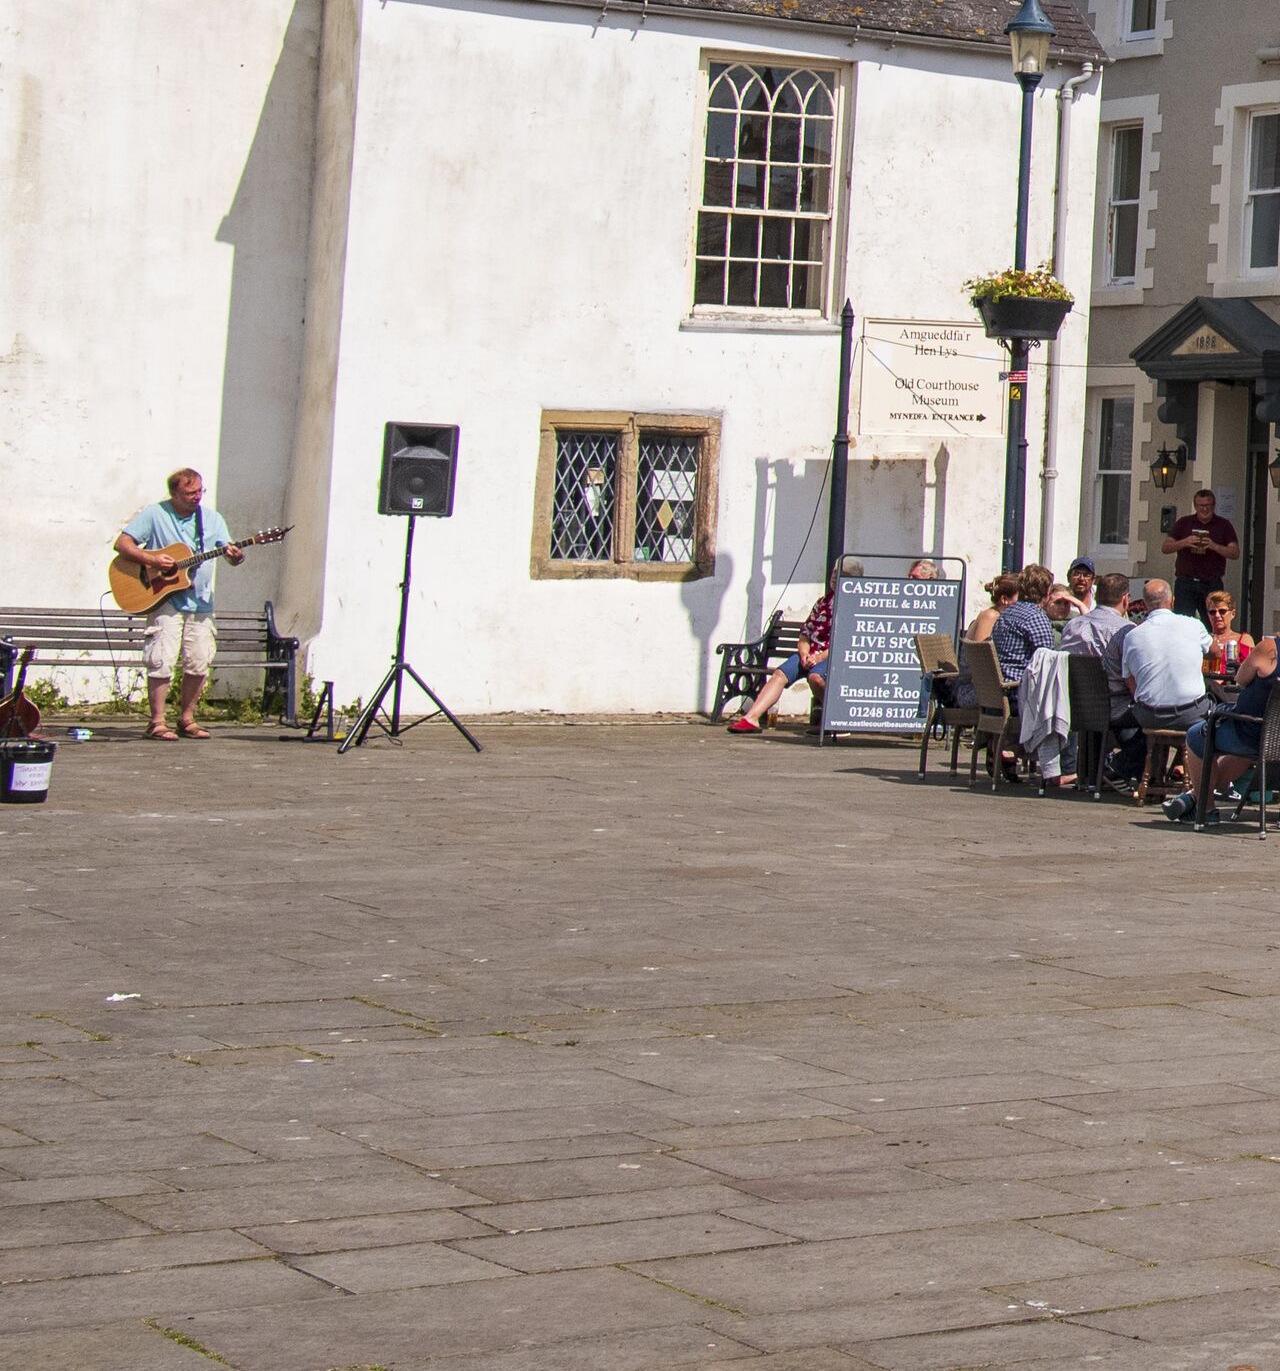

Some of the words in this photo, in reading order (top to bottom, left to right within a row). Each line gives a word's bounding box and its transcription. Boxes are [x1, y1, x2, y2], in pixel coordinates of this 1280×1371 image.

[899, 328, 971, 342] Amgueddfa'r
[914, 345, 937, 356] Hen
[939, 346, 958, 359] Lys
[894, 378, 914, 390] Old
[917, 379, 980, 391] Courthouse
[911, 394, 960, 407] Museum
[932, 413, 975, 422] ENTRANCE
[841, 581, 901, 596] CASTLE
[903, 583, 958, 597] COURT
[859, 597, 898, 609] HOTEL
[901, 599, 911, 609] &
[913, 599, 937, 610] BAR
[855, 620, 895, 634] REAL
[898, 622, 937, 635] ALES
[851, 635, 886, 649] LIVE
[844, 650, 879, 663] HOT
[882, 673, 900, 685] 12
[840, 685, 892, 698] Ensuite
[849, 706, 883, 718] 01248
[885, 707, 919, 719] 81107
